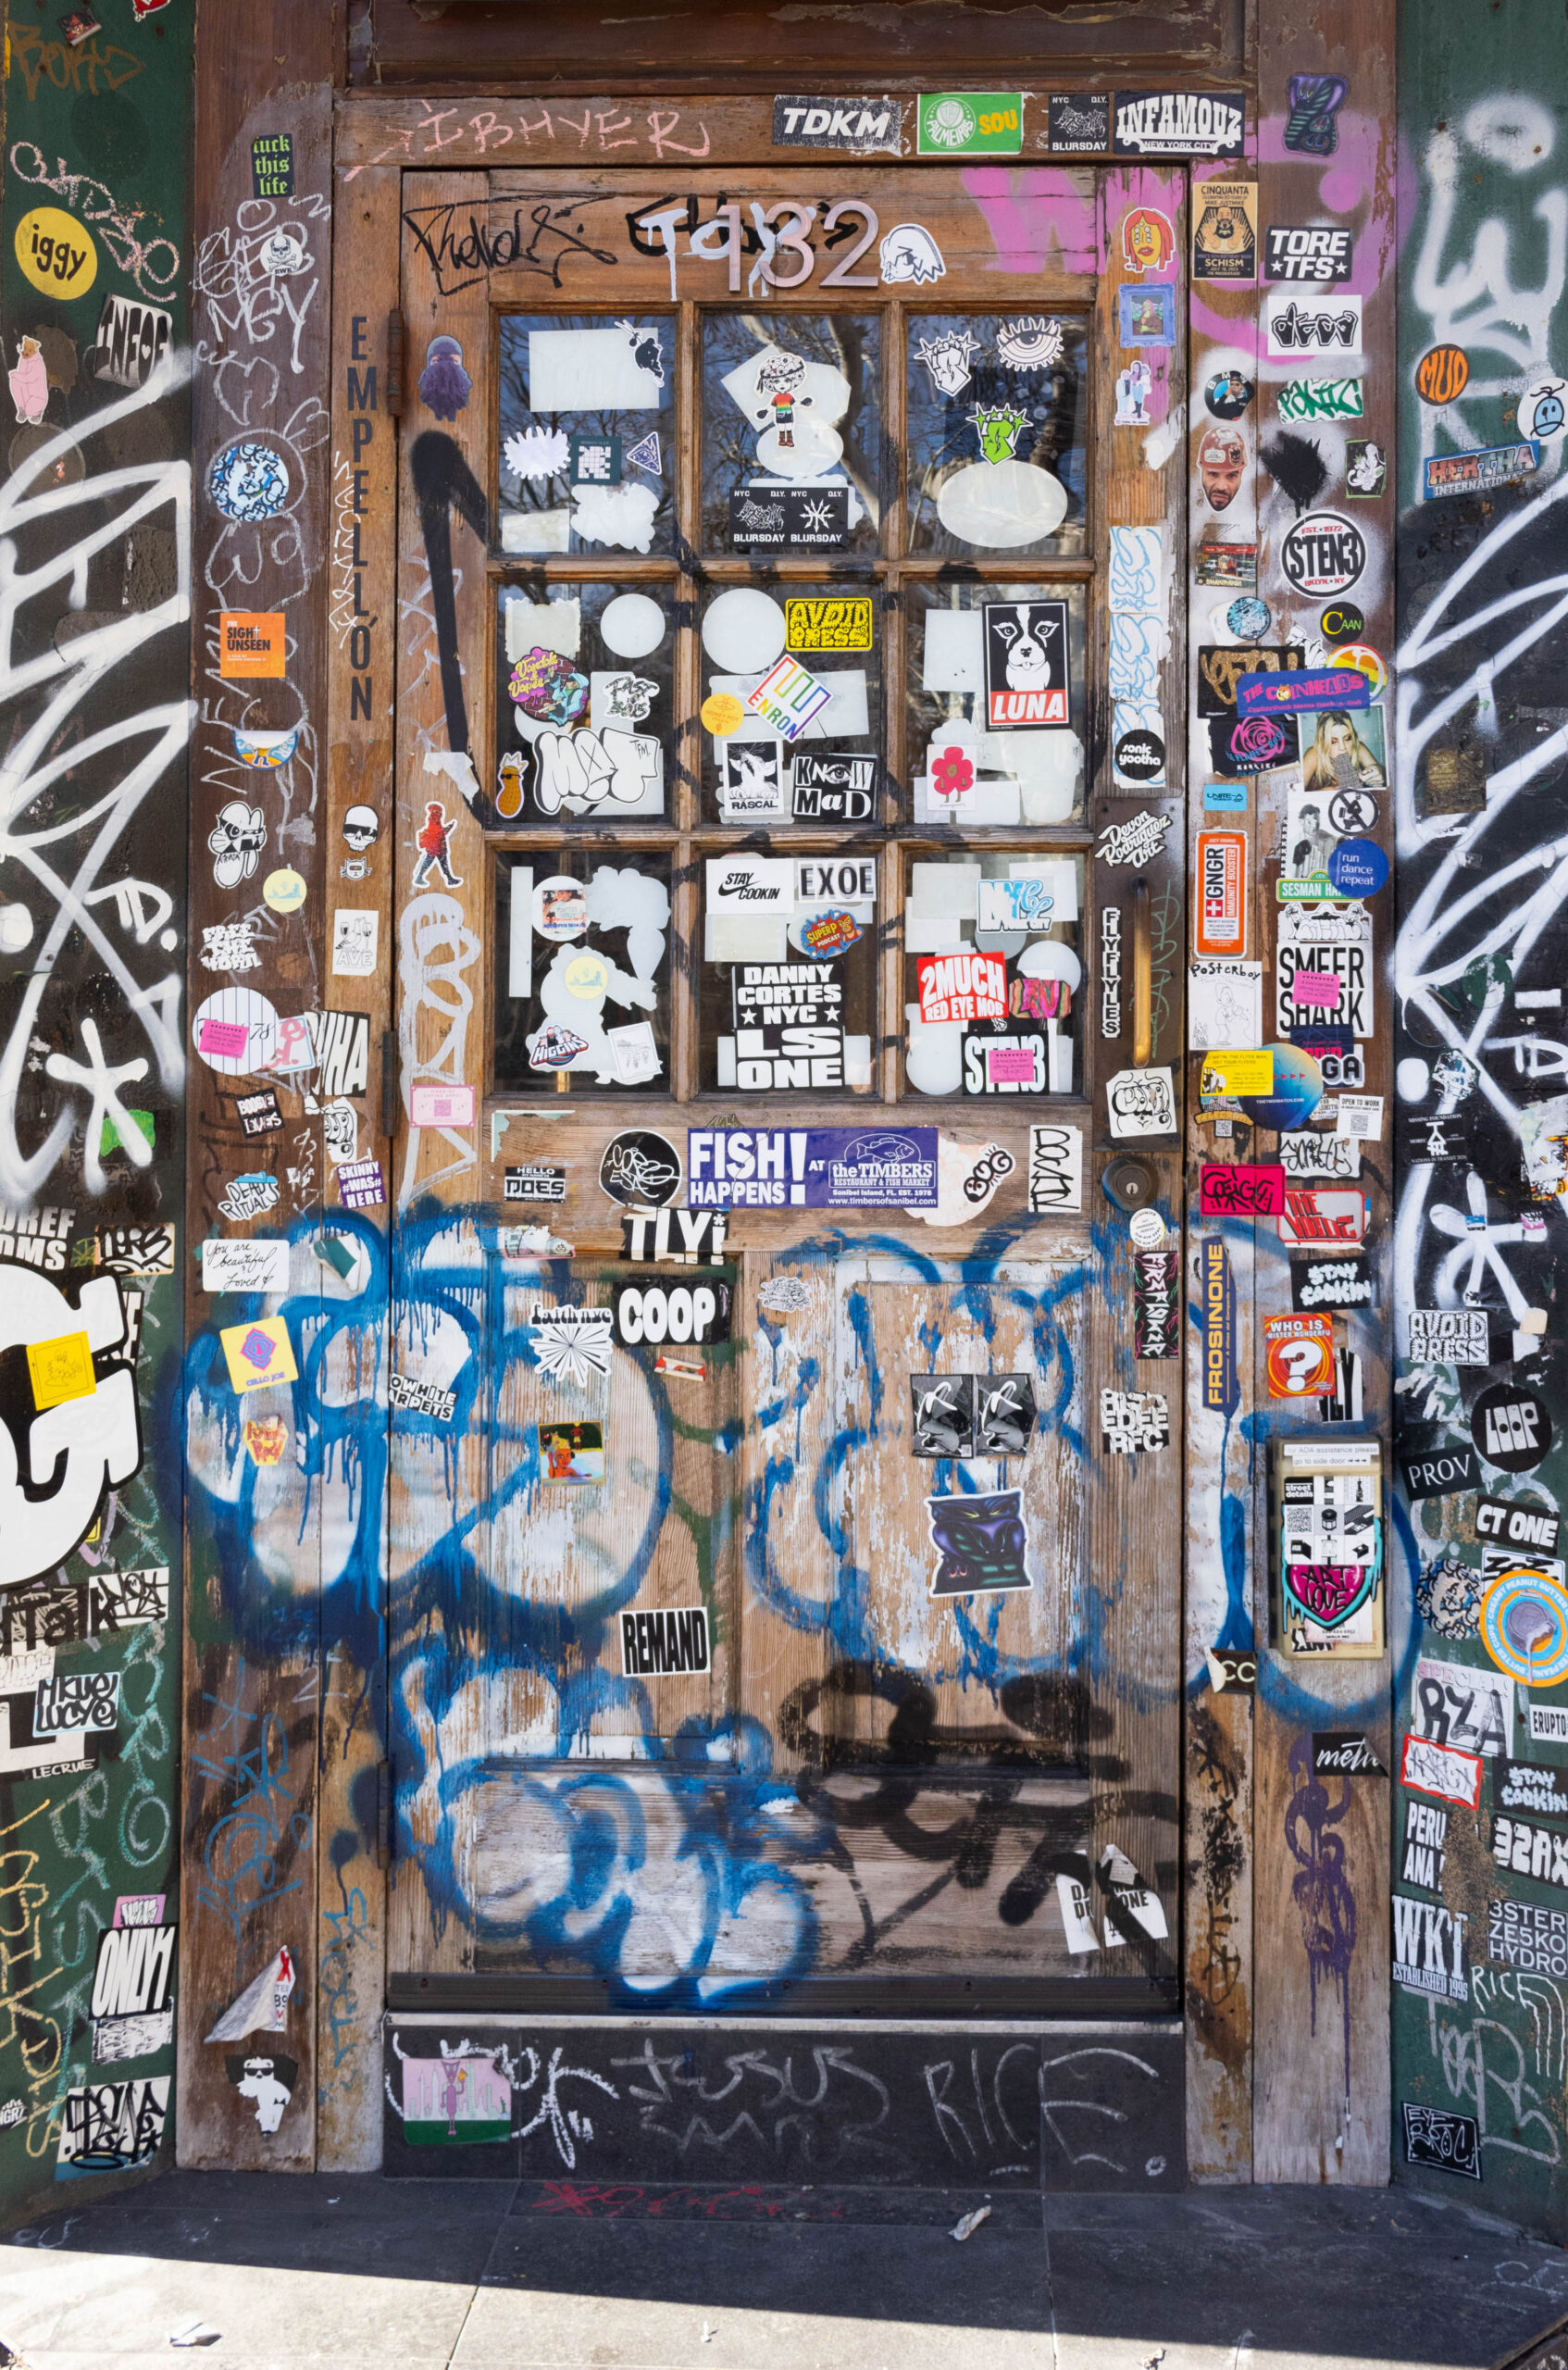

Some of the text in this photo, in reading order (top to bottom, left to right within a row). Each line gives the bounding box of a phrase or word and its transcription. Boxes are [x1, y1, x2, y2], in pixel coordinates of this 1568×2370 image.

[783, 108, 890, 138] TDKM
[978, 109, 1017, 135] SOU
[1116, 94, 1242, 139] INFAMOUZ
[927, 119, 974, 147] PALMEIRAS
[1052, 142, 1108, 151] BLURSDAY
[1144, 141, 1215, 149] NEW YORK CITY
[255, 157, 290, 176] this
[259, 178, 288, 196] life
[1201, 186, 1250, 195] CINQUANTA
[31, 224, 87, 281] iggy
[1271, 230, 1350, 256] TORE
[1283, 256, 1336, 280] TFS
[1419, 349, 1468, 404] MUD
[1428, 445, 1536, 487] HERTHA
[733, 533, 786, 543] BLURSDAY
[790, 533, 842, 543] BLURSDAY
[1289, 531, 1361, 579] STEN3
[227, 639, 271, 652] UNSEEN
[1242, 682, 1264, 704] THE
[747, 692, 798, 742] ENRON
[992, 692, 1065, 721] LUNA
[1122, 743, 1152, 755] sonic
[731, 800, 778, 810] RASCAL
[1341, 862, 1374, 875] dance
[1342, 854, 1360, 863] run
[725, 872, 754, 886] STAY
[800, 863, 875, 898] EXOE
[1206, 848, 1225, 899] GNGR
[1226, 848, 1237, 917] IMMUNITY BOOSTER
[1341, 874, 1375, 886] repeat
[738, 887, 781, 900] COOKIN
[1282, 882, 1322, 897] SESMAN
[817, 932, 841, 947] PODCAST
[743, 964, 834, 986] DANNY
[920, 956, 1006, 1009] 2MUCH
[737, 983, 842, 1005] CORTES
[763, 1004, 817, 1025] NYC
[926, 1001, 950, 1022] RED
[951, 997, 975, 1019] EYE
[977, 994, 1004, 1017] MOB
[532, 1036, 590, 1066] HIGGINS
[737, 1027, 841, 1058] LS
[737, 1057, 843, 1091] ONE
[1429, 1113, 1462, 1121] FOUNDATION
[338, 1161, 380, 1180] SKINNY
[516, 1166, 555, 1175] HELLO
[808, 1160, 826, 1172] AT
[832, 1162, 933, 1179] the TIMBERS
[342, 1177, 382, 1194] #WAS#
[690, 1181, 786, 1204] HAPPENS
[833, 1179, 930, 1187] RESTAURANT & FISH MARKET
[346, 1188, 384, 1209] HERE
[828, 1196, 937, 1205] www.timbersofsanibel.com
[1288, 1192, 1322, 1216] THE
[1308, 1262, 1359, 1286] STAY
[1300, 1279, 1372, 1304] COOKIN
[531, 1304, 611, 1325] faith nyc
[618, 1287, 716, 1344] COOP
[1208, 1243, 1224, 1404] FROSINONE
[1270, 1320, 1324, 1332] WHO IS
[1410, 1310, 1487, 1341] AVOID
[401, 1379, 457, 1406] WHITE
[1110, 1429, 1164, 1453] RFC
[1354, 1446, 1378, 1455] please
[1408, 1453, 1471, 1490] PROV
[1285, 1482, 1312, 1491] street
[1285, 1491, 1313, 1499] details
[1476, 1503, 1559, 1548] CT ONE
[1487, 1584, 1508, 1619] CREAMY
[1506, 1578, 1537, 1588] PEANUT
[621, 1611, 709, 1675] REMAND
[1508, 1767, 1557, 1790] STAY
[1500, 1785, 1568, 1813] COOKIN
[1402, 1842, 1435, 1892] ANA
[1489, 1899, 1567, 1933] 3STER
[1489, 1940, 1568, 1977] HYDRO
[1391, 1961, 1469, 2002] ESTABLISHED 1995
